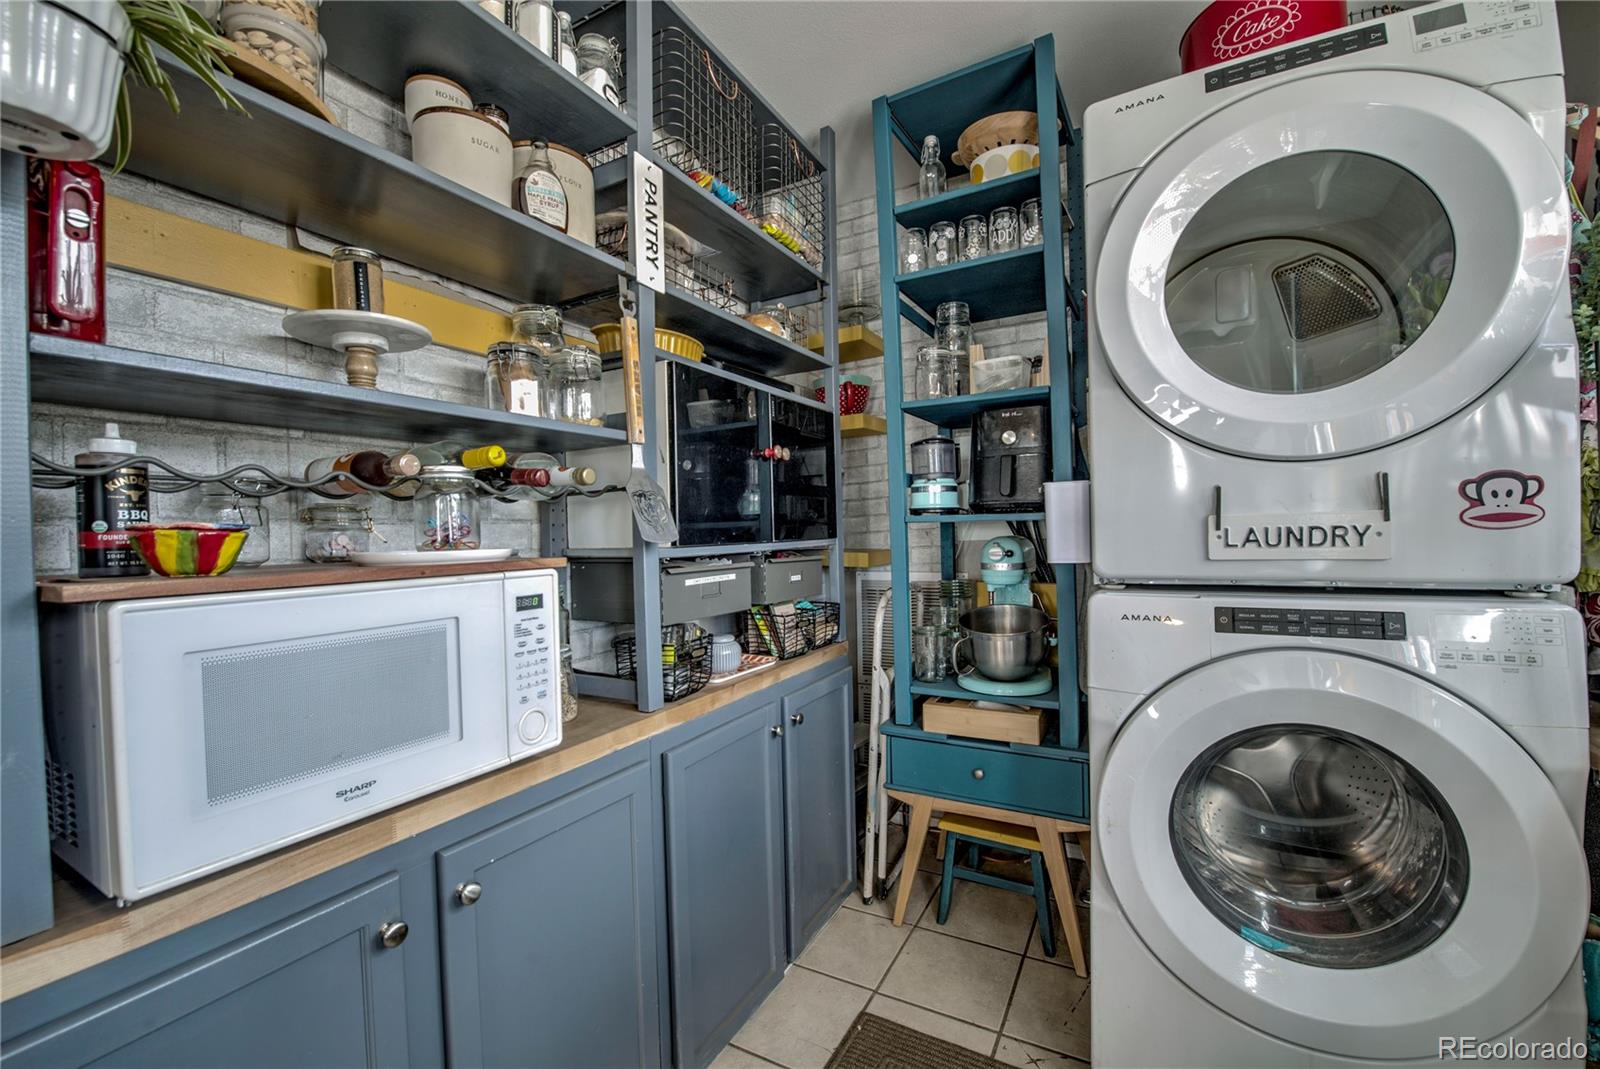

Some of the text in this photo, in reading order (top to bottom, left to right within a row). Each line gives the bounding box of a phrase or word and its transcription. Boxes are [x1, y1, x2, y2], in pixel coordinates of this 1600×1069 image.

[1233, 12, 1280, 42] Cake
[435, 90, 464, 107] HONEY
[1114, 94, 1165, 114] AMANA
[471, 137, 500, 154] SUGAR
[644, 177, 659, 271] PANTRY
[117, 509, 149, 521] BBQ
[1223, 524, 1373, 549] LAUNDRY
[1120, 613, 1172, 622] AMANA
[335, 780, 377, 799] SHARP
